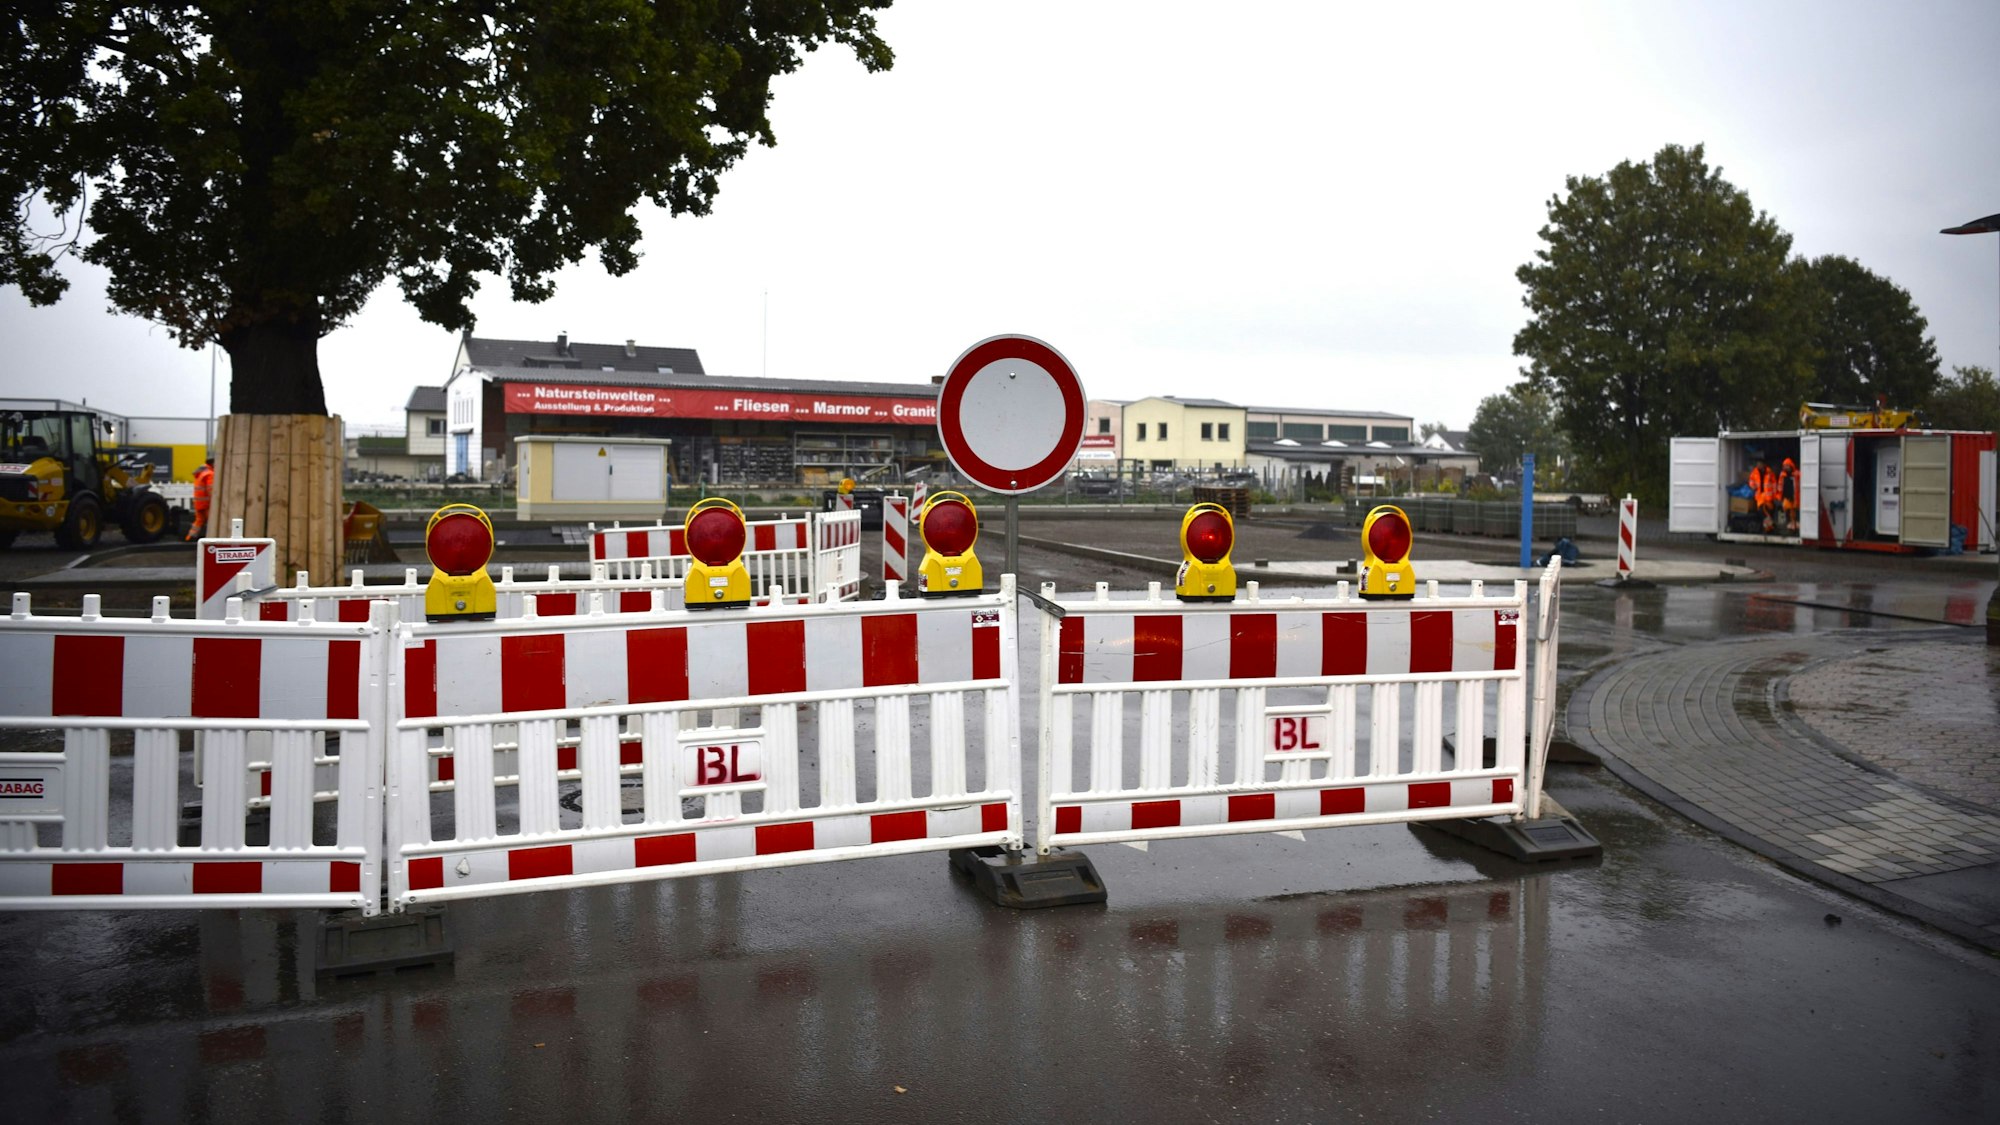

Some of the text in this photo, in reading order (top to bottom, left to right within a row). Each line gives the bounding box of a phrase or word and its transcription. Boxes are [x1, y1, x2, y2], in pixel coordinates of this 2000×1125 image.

[534, 386, 656, 402] Natursteinwelten
[534, 401, 655, 414] Ausstellung & Produktion
[733, 398, 790, 413] Fliesen
[813, 401, 871, 416] Marmor
[892, 404, 937, 418] Granit
[217, 551, 255, 559] STRABAG
[1275, 716, 1320, 751] BL
[697, 745, 758, 785] BL
